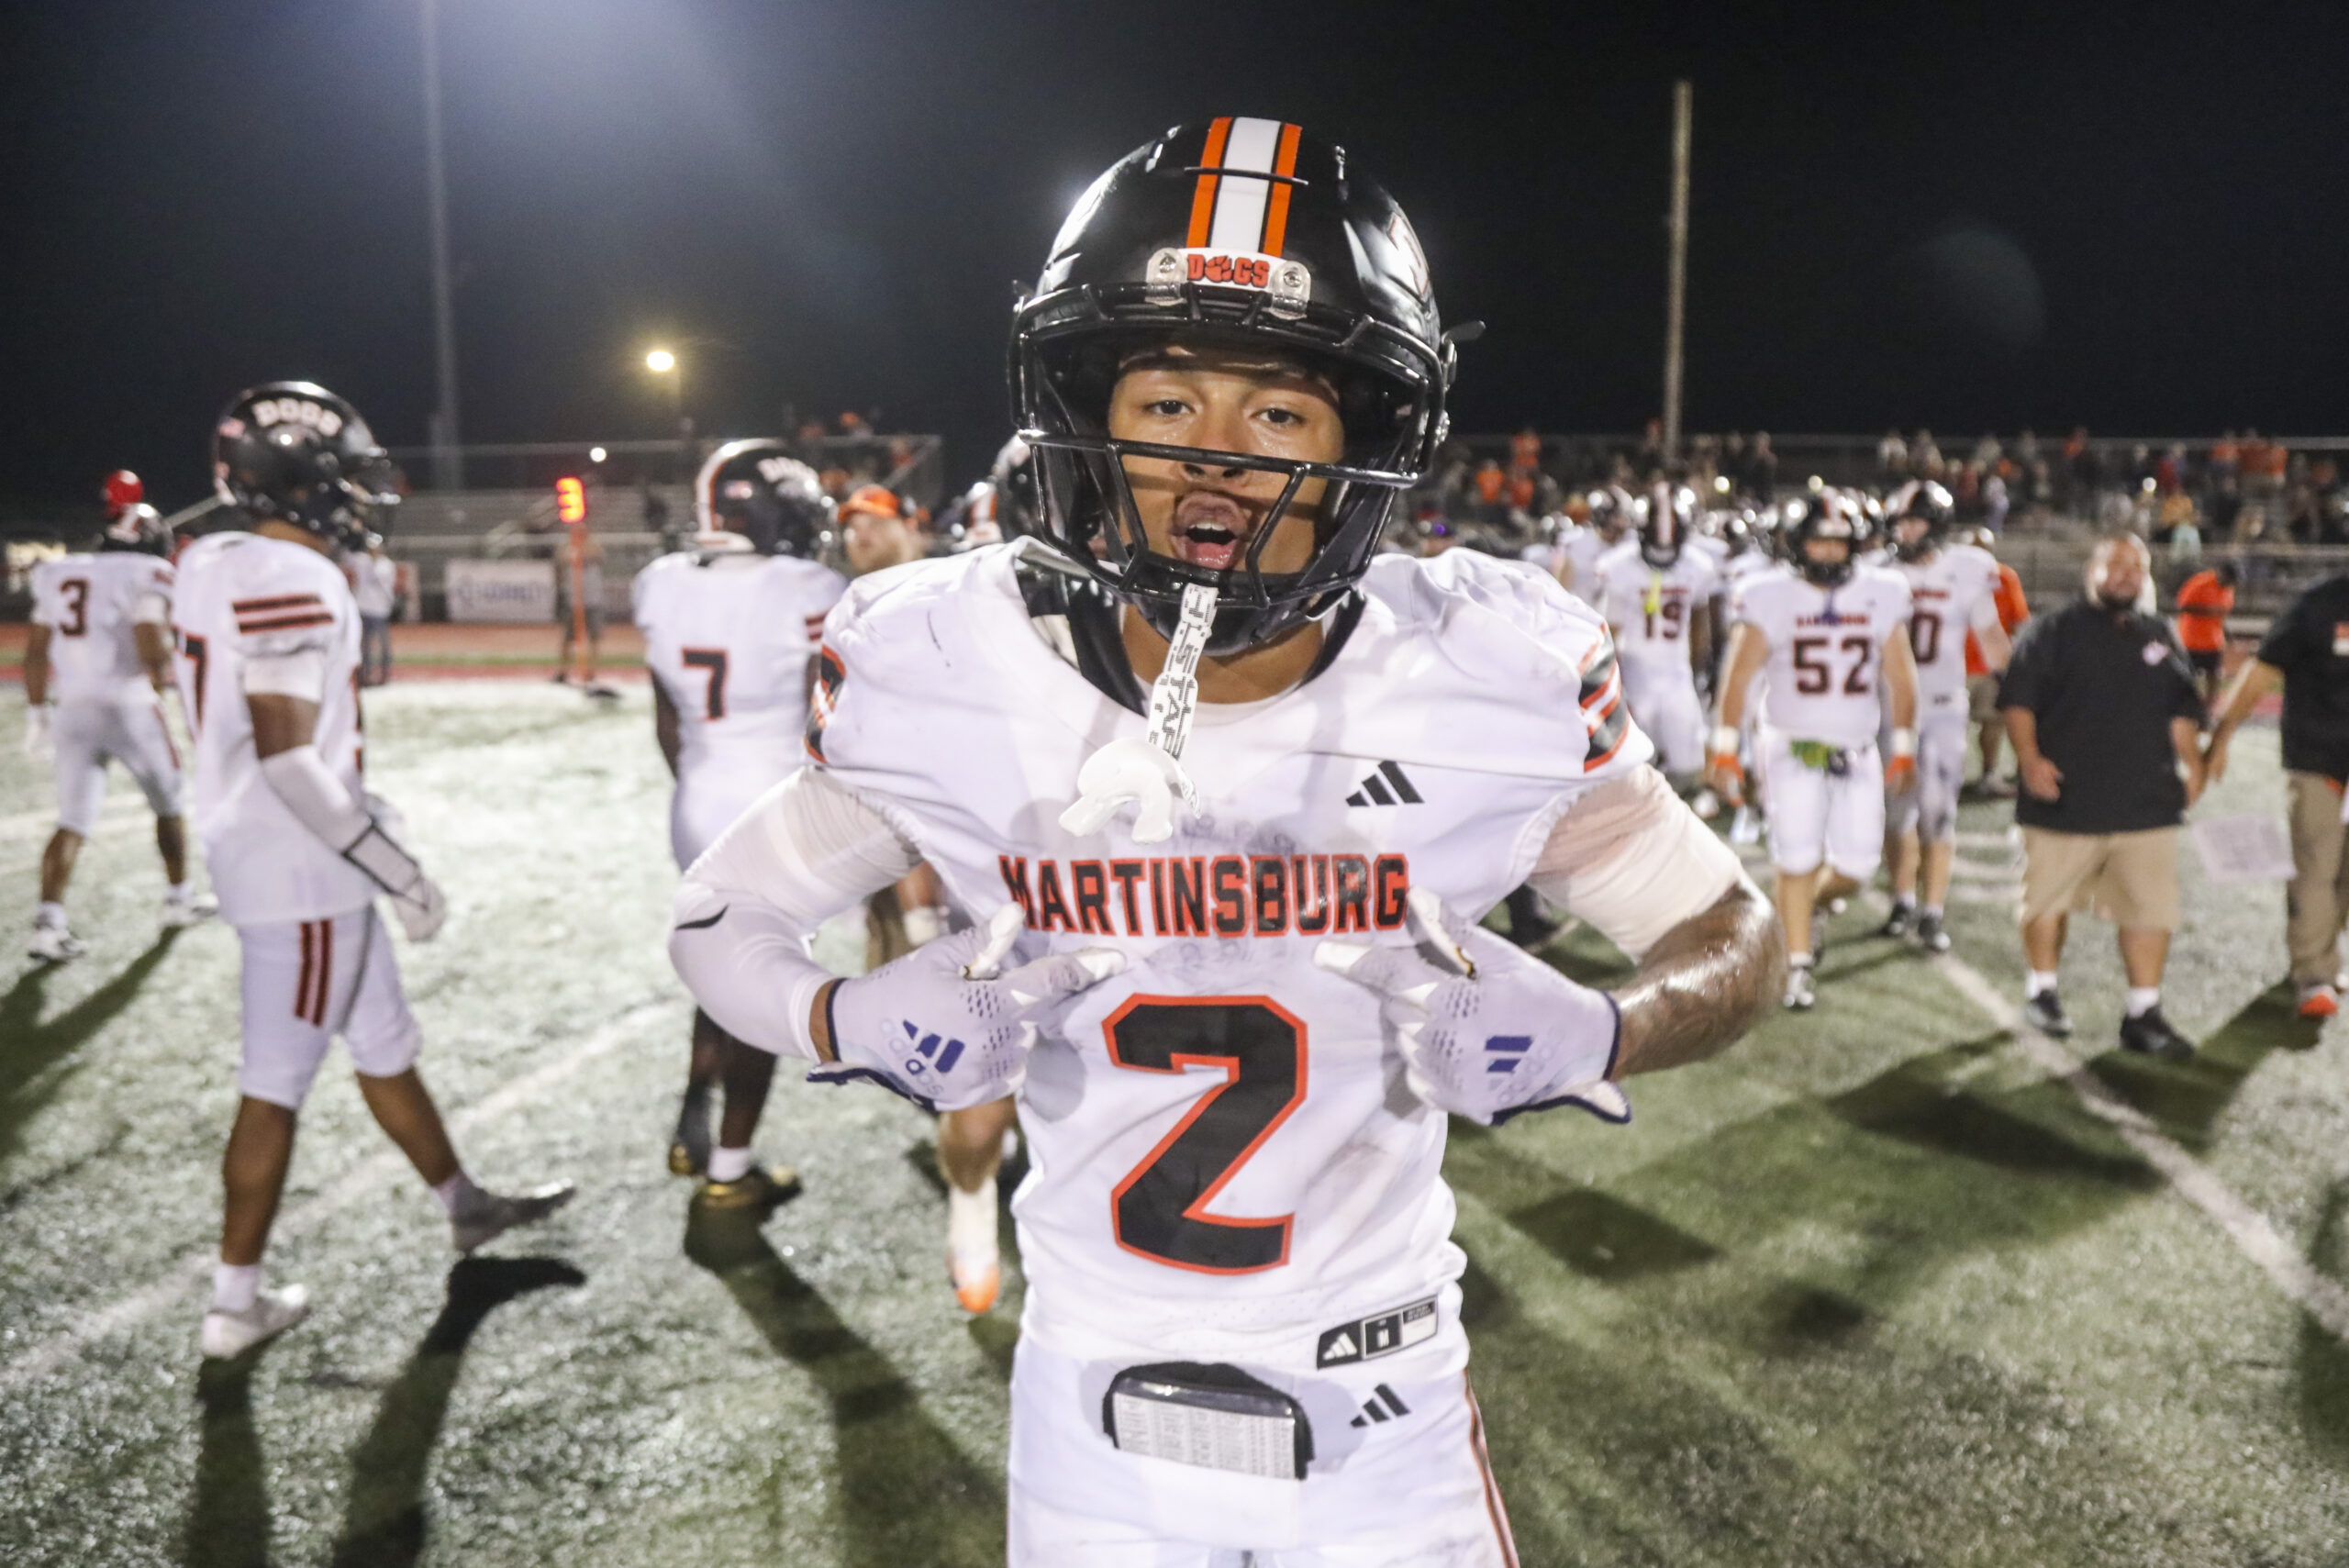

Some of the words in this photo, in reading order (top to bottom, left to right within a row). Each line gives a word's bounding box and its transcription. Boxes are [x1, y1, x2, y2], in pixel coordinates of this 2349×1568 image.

[59, 576, 89, 637] 3
[681, 646, 728, 722] 7
[1794, 636, 1870, 696] 52
[998, 853, 1409, 939] MARTINSBURG
[1101, 993, 1308, 1276] 2
